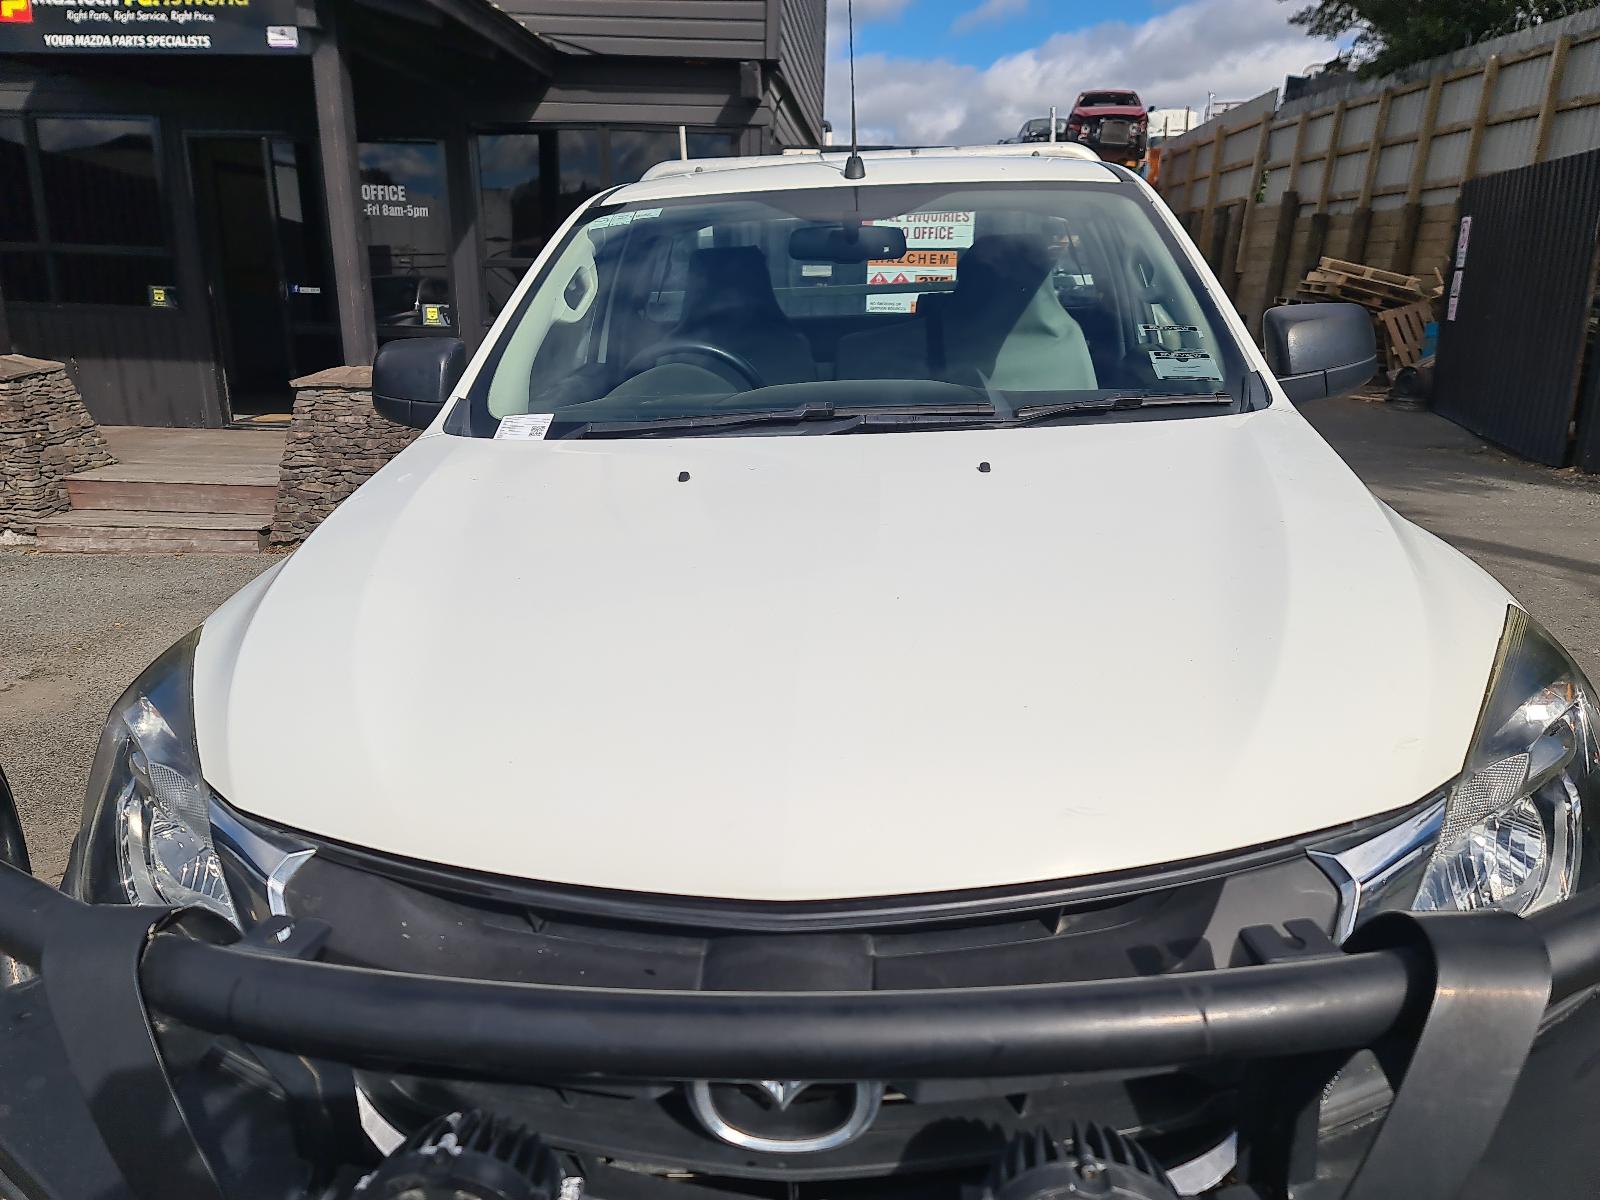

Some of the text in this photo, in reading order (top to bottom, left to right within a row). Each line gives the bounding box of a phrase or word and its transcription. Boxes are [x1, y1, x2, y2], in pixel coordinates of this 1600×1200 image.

[66, 9, 88, 23] Right
[89, 10, 112, 22] Parts,
[114, 10, 136, 24] Right
[170, 10, 193, 24] Right
[44, 34, 211, 48] YOUR MAZDA PARTS SPECIALISTS
[361, 185, 406, 201] OFFICE
[382, 204, 429, 217] 8am-5pm
[906, 211, 970, 223] ENQUIRIES
[913, 227, 954, 240] OFFICE
[875, 254, 949, 265] ZCHEM
